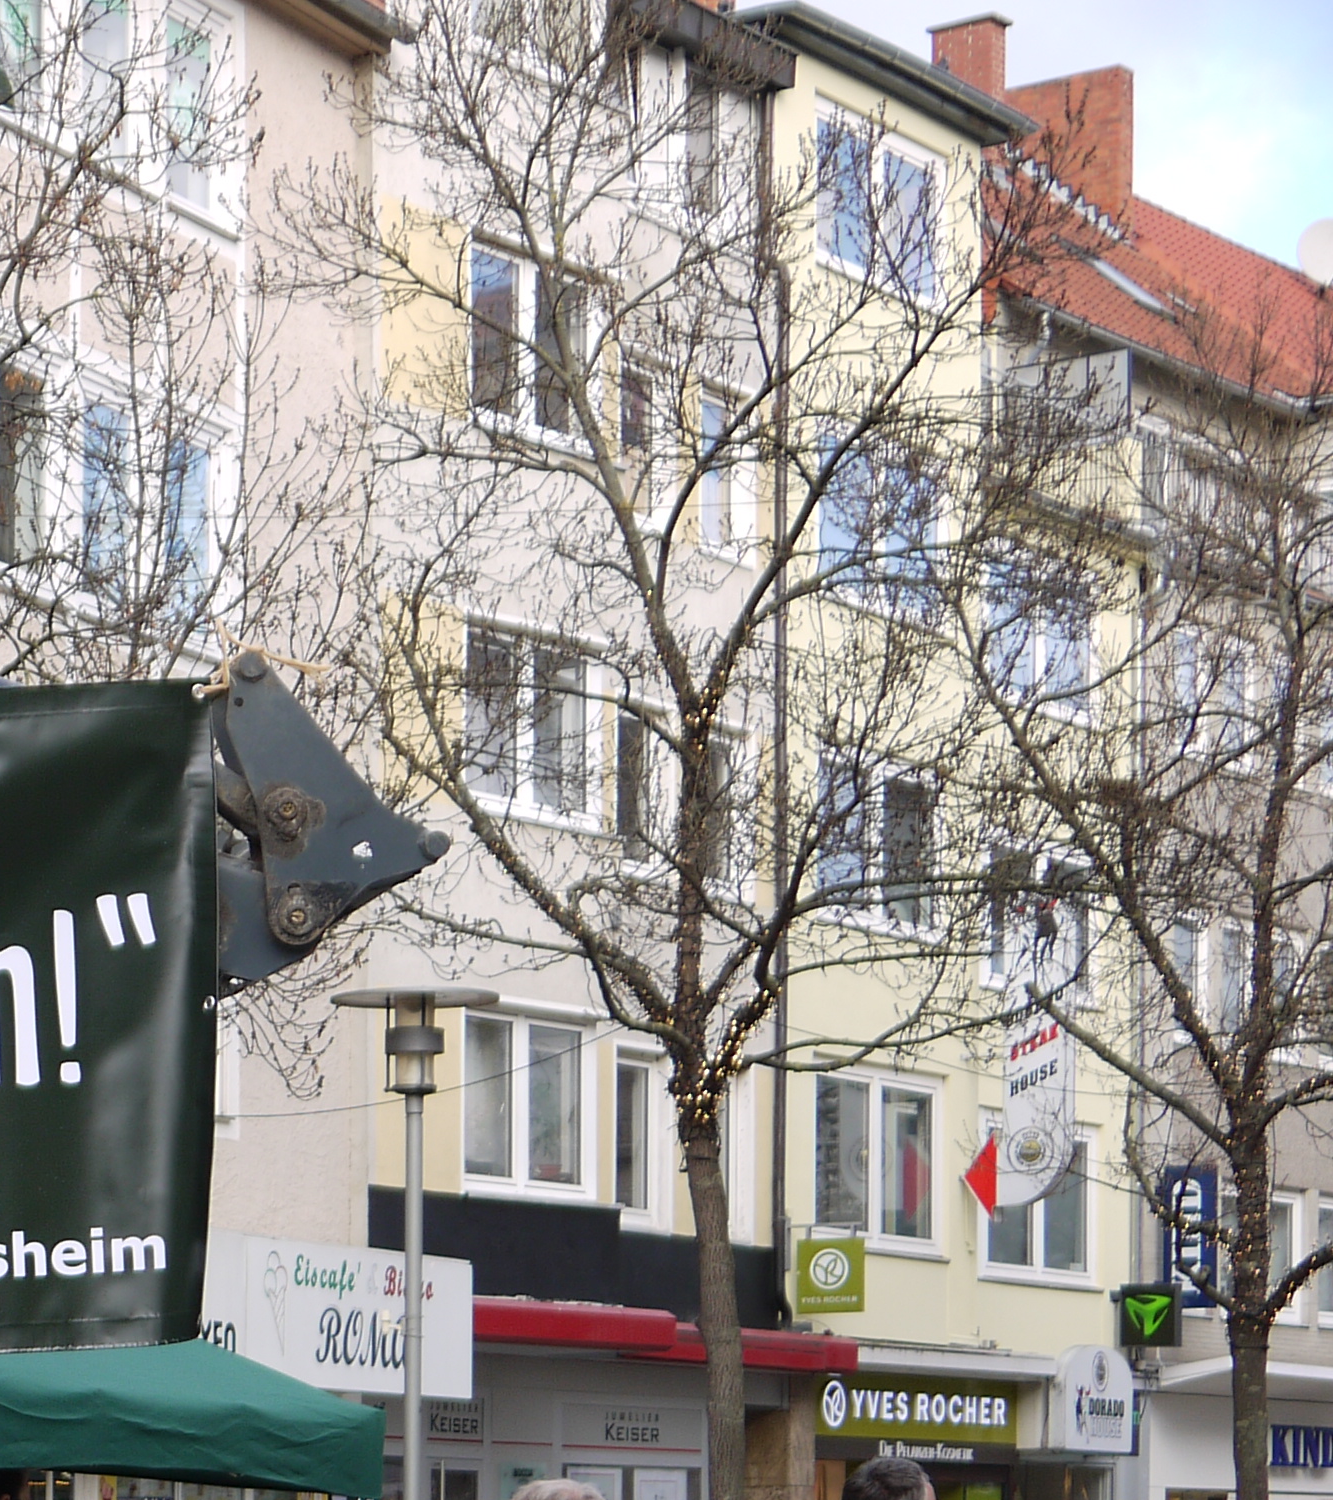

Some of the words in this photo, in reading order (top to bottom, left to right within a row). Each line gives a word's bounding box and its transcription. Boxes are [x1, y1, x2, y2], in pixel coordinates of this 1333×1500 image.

[1010, 1059, 1058, 1097] HOUSE
[605, 1411, 660, 1422] JUWELIER
[851, 1389, 909, 1421] YVES
[915, 1393, 1006, 1426] ROCHER
[1088, 1398, 1125, 1417] DORADO
